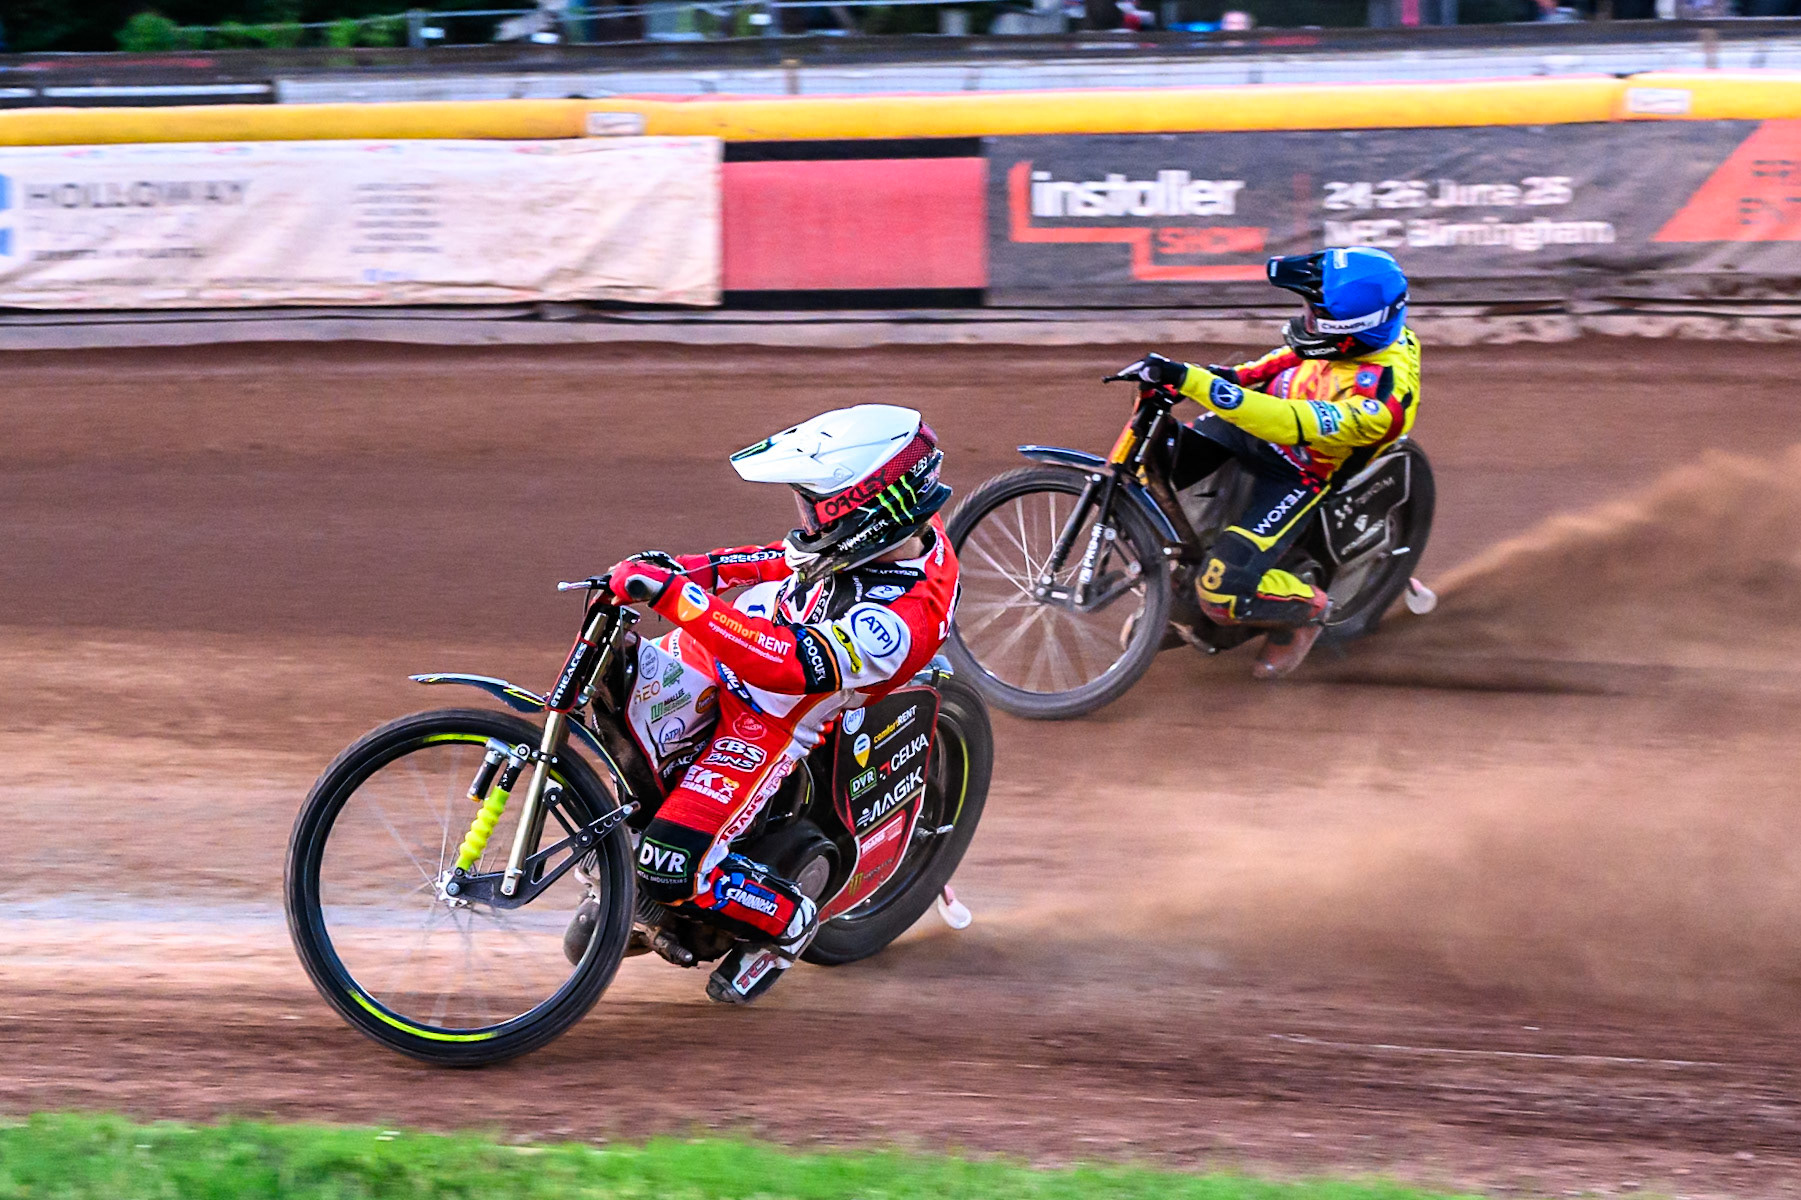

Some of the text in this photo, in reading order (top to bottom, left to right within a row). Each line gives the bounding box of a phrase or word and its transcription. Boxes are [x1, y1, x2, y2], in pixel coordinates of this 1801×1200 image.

[1031, 170, 1245, 216] installer
[825, 469, 887, 517] OAKLEY
[1253, 489, 1307, 534] TEXOM
[860, 616, 893, 650] ATPI
[708, 752, 755, 769] BINS
[714, 740, 764, 762] CBS
[891, 733, 929, 771] CELKA
[852, 771, 875, 793] DVR
[639, 842, 687, 874] DVR
